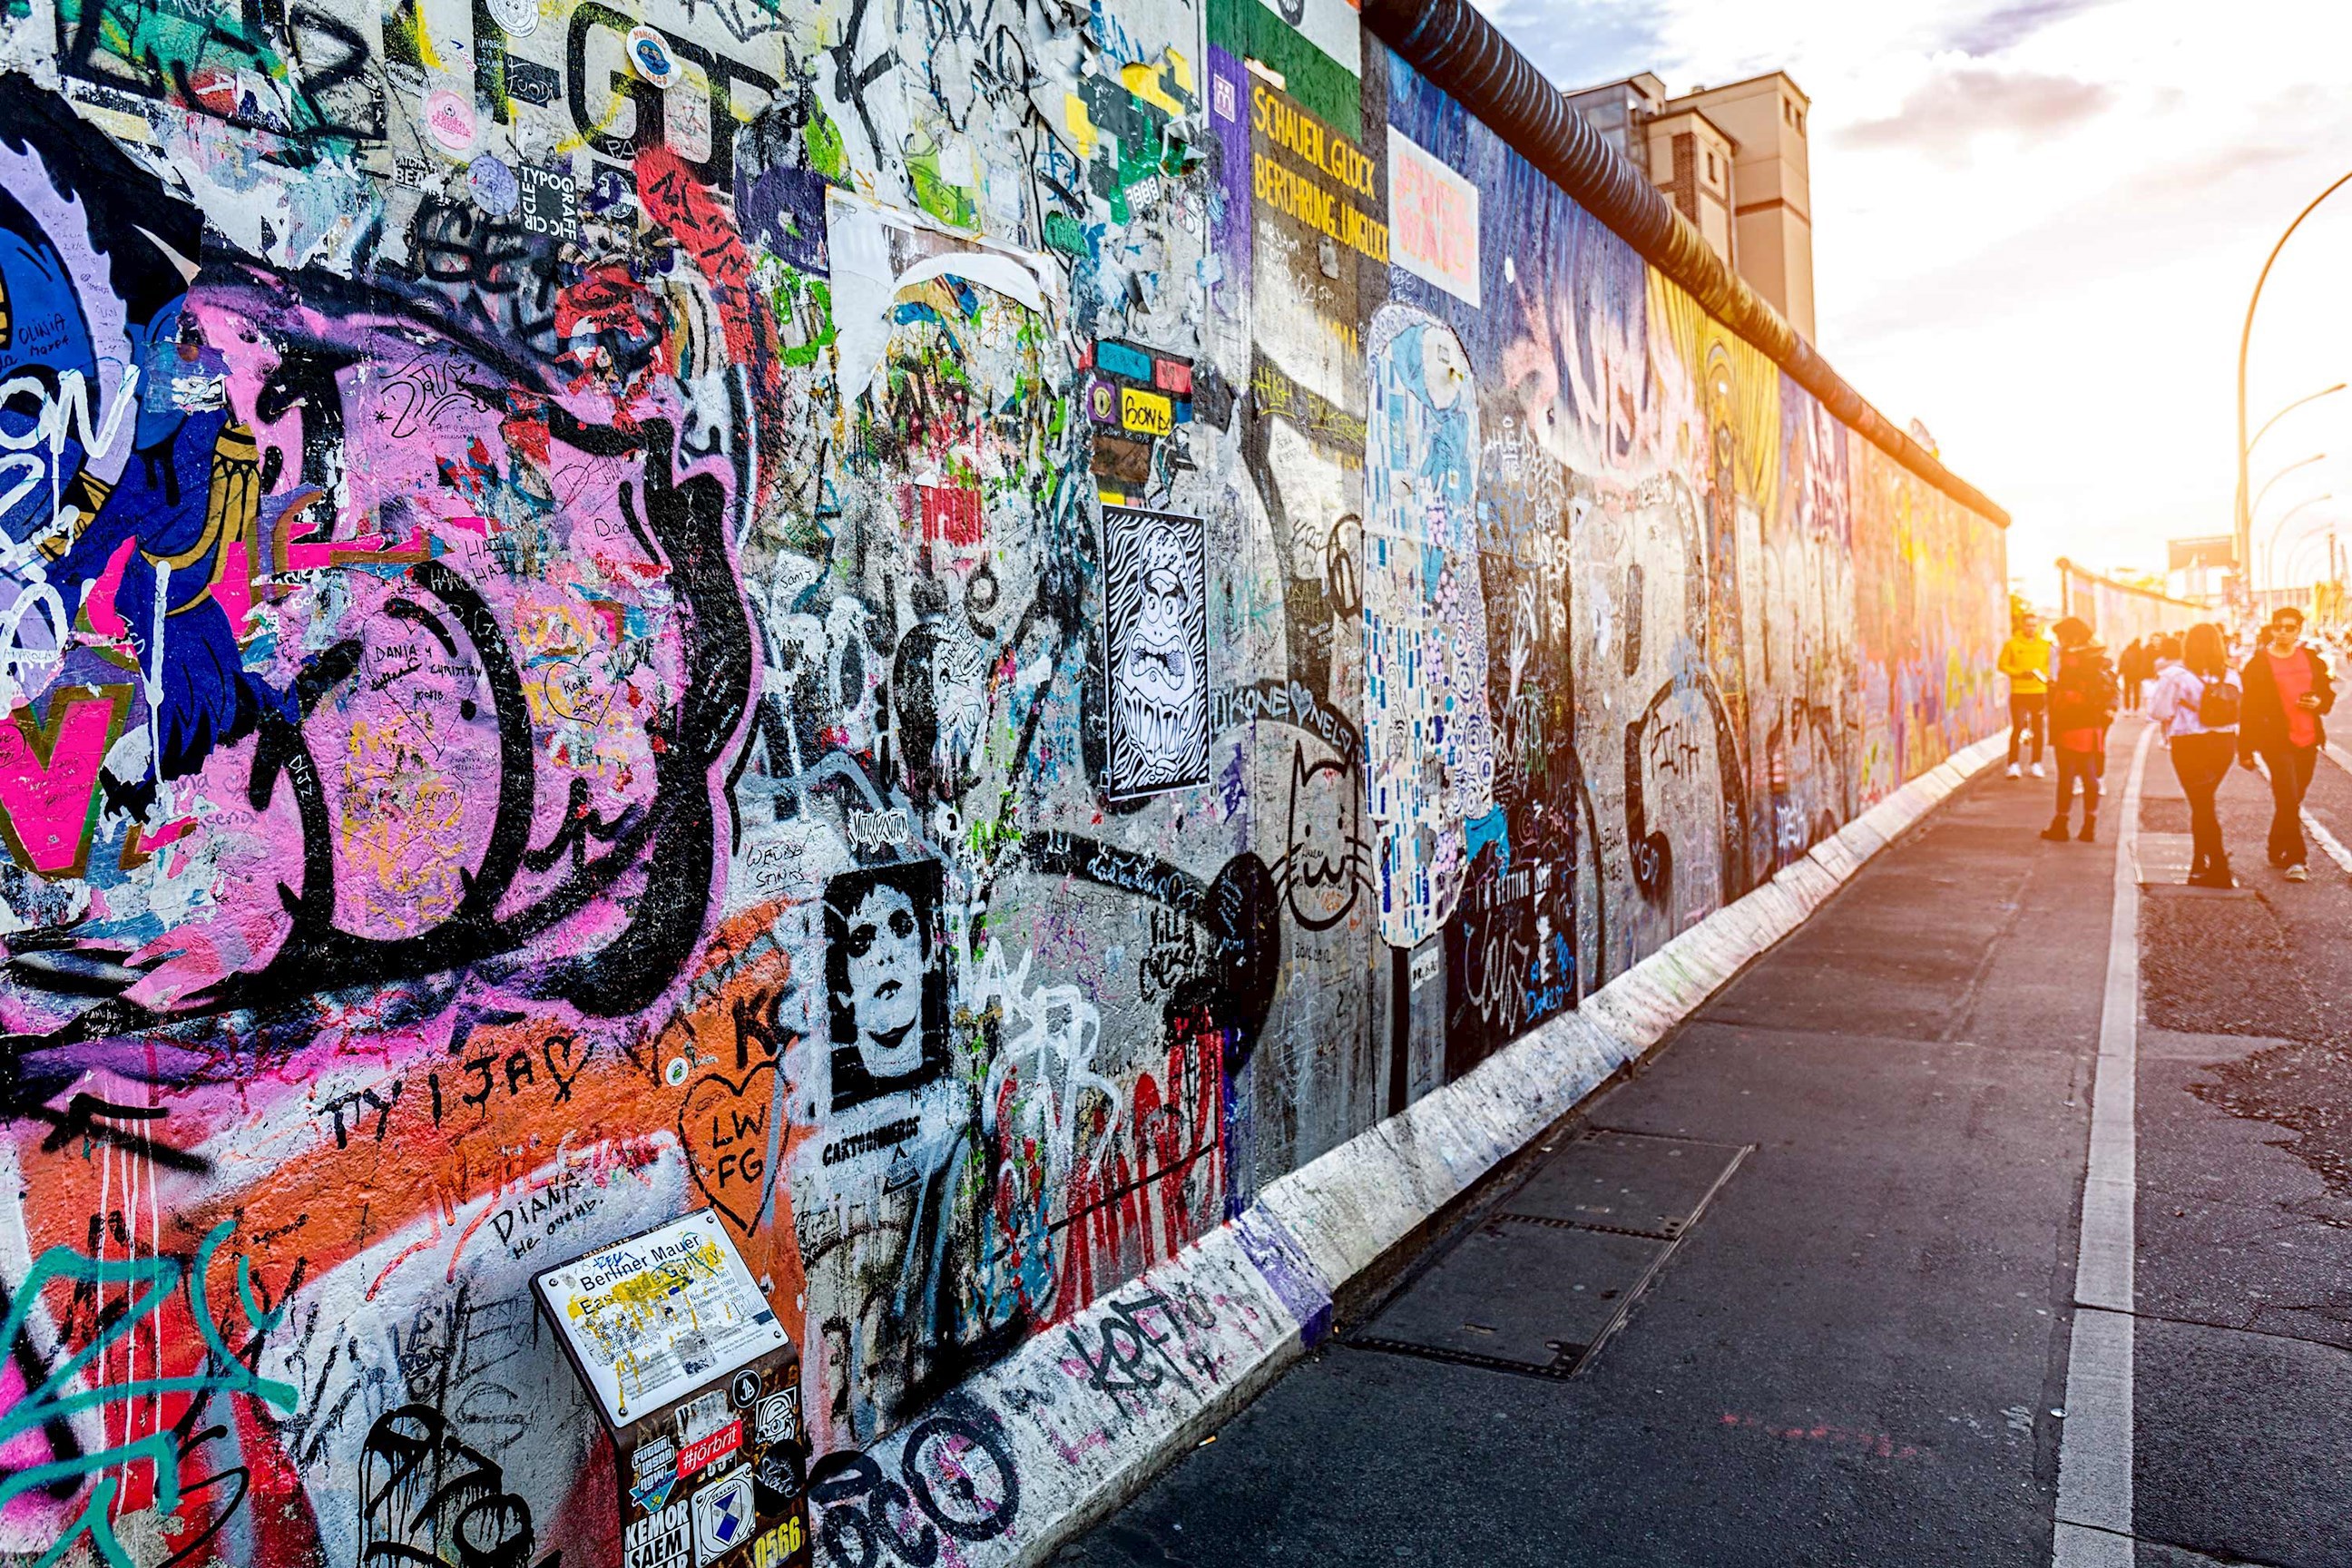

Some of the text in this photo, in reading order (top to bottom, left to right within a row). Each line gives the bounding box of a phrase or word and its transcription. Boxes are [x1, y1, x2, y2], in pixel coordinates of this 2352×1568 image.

[579, 1256, 649, 1293] Berliner
[650, 1234, 701, 1262] Mauer
[682, 1427, 738, 1470] #jörbrit
[624, 1500, 690, 1551] KEMOR
